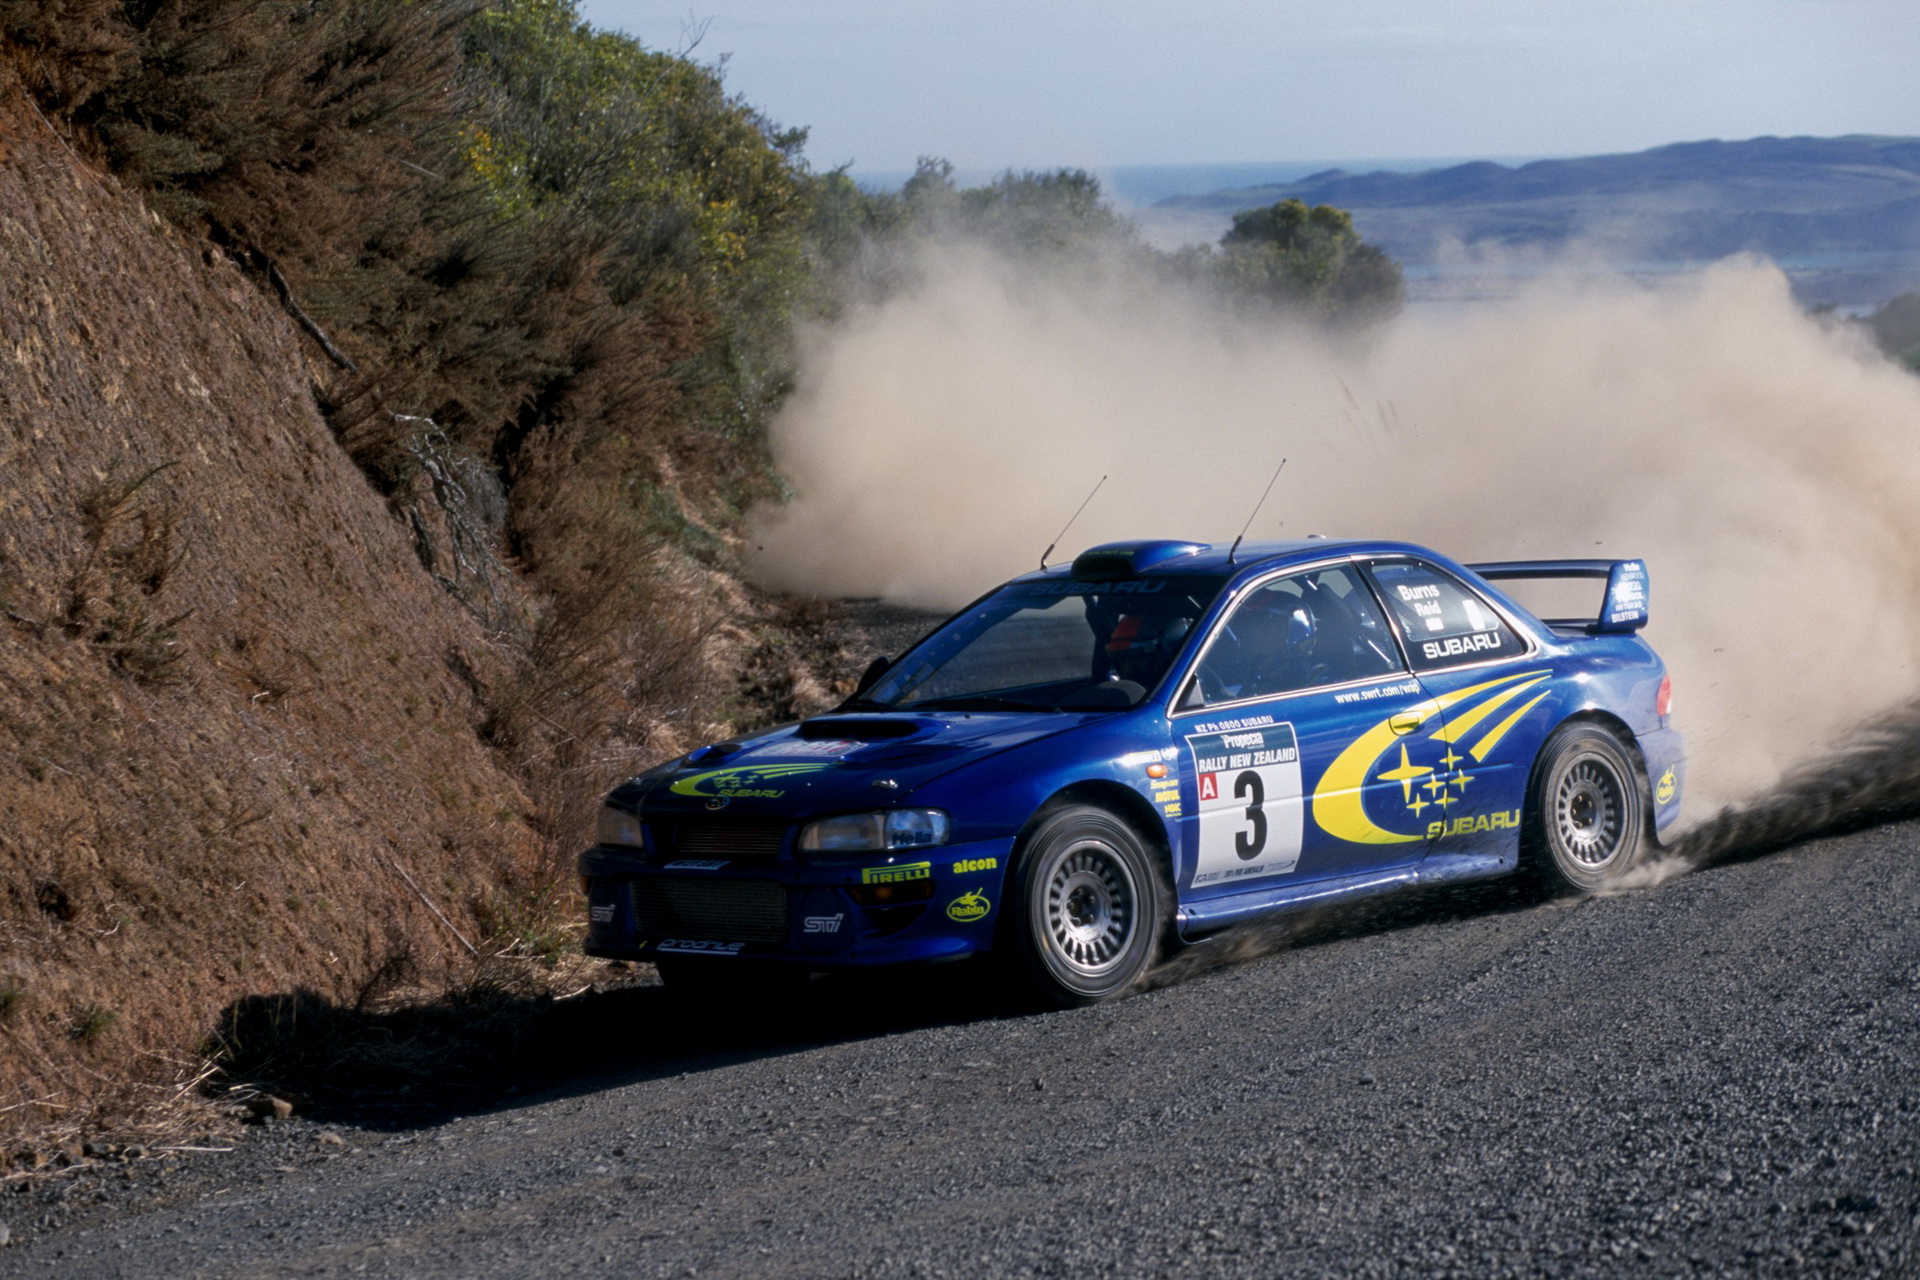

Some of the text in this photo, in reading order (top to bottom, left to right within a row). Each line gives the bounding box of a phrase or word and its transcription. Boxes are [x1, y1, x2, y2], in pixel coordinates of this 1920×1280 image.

[1029, 580, 1168, 595] SUBARU
[1397, 584, 1440, 601] Burns
[1414, 600, 1442, 617] Reid
[1611, 610, 1639, 623] BILSTEIN
[1423, 632, 1501, 659] SUBARU
[1334, 683, 1421, 703] www.swrt.com/wap
[1195, 715, 1274, 733] NZ Ph 0800 SUBARU
[1220, 732, 1264, 749] Propecia
[1198, 747, 1296, 773] RALLY NEW ZEALAND
[718, 789, 786, 798] SUBARU
[1202, 776, 1216, 798] A
[1164, 802, 1181, 814] NGK
[1234, 770, 1267, 861] 3
[1426, 808, 1520, 840] SUBARU
[892, 831, 932, 846] Hella
[862, 861, 931, 884] PIRELLI
[953, 857, 997, 874] alcon
[951, 905, 985, 916] Robin
[657, 939, 746, 952] prodrive
